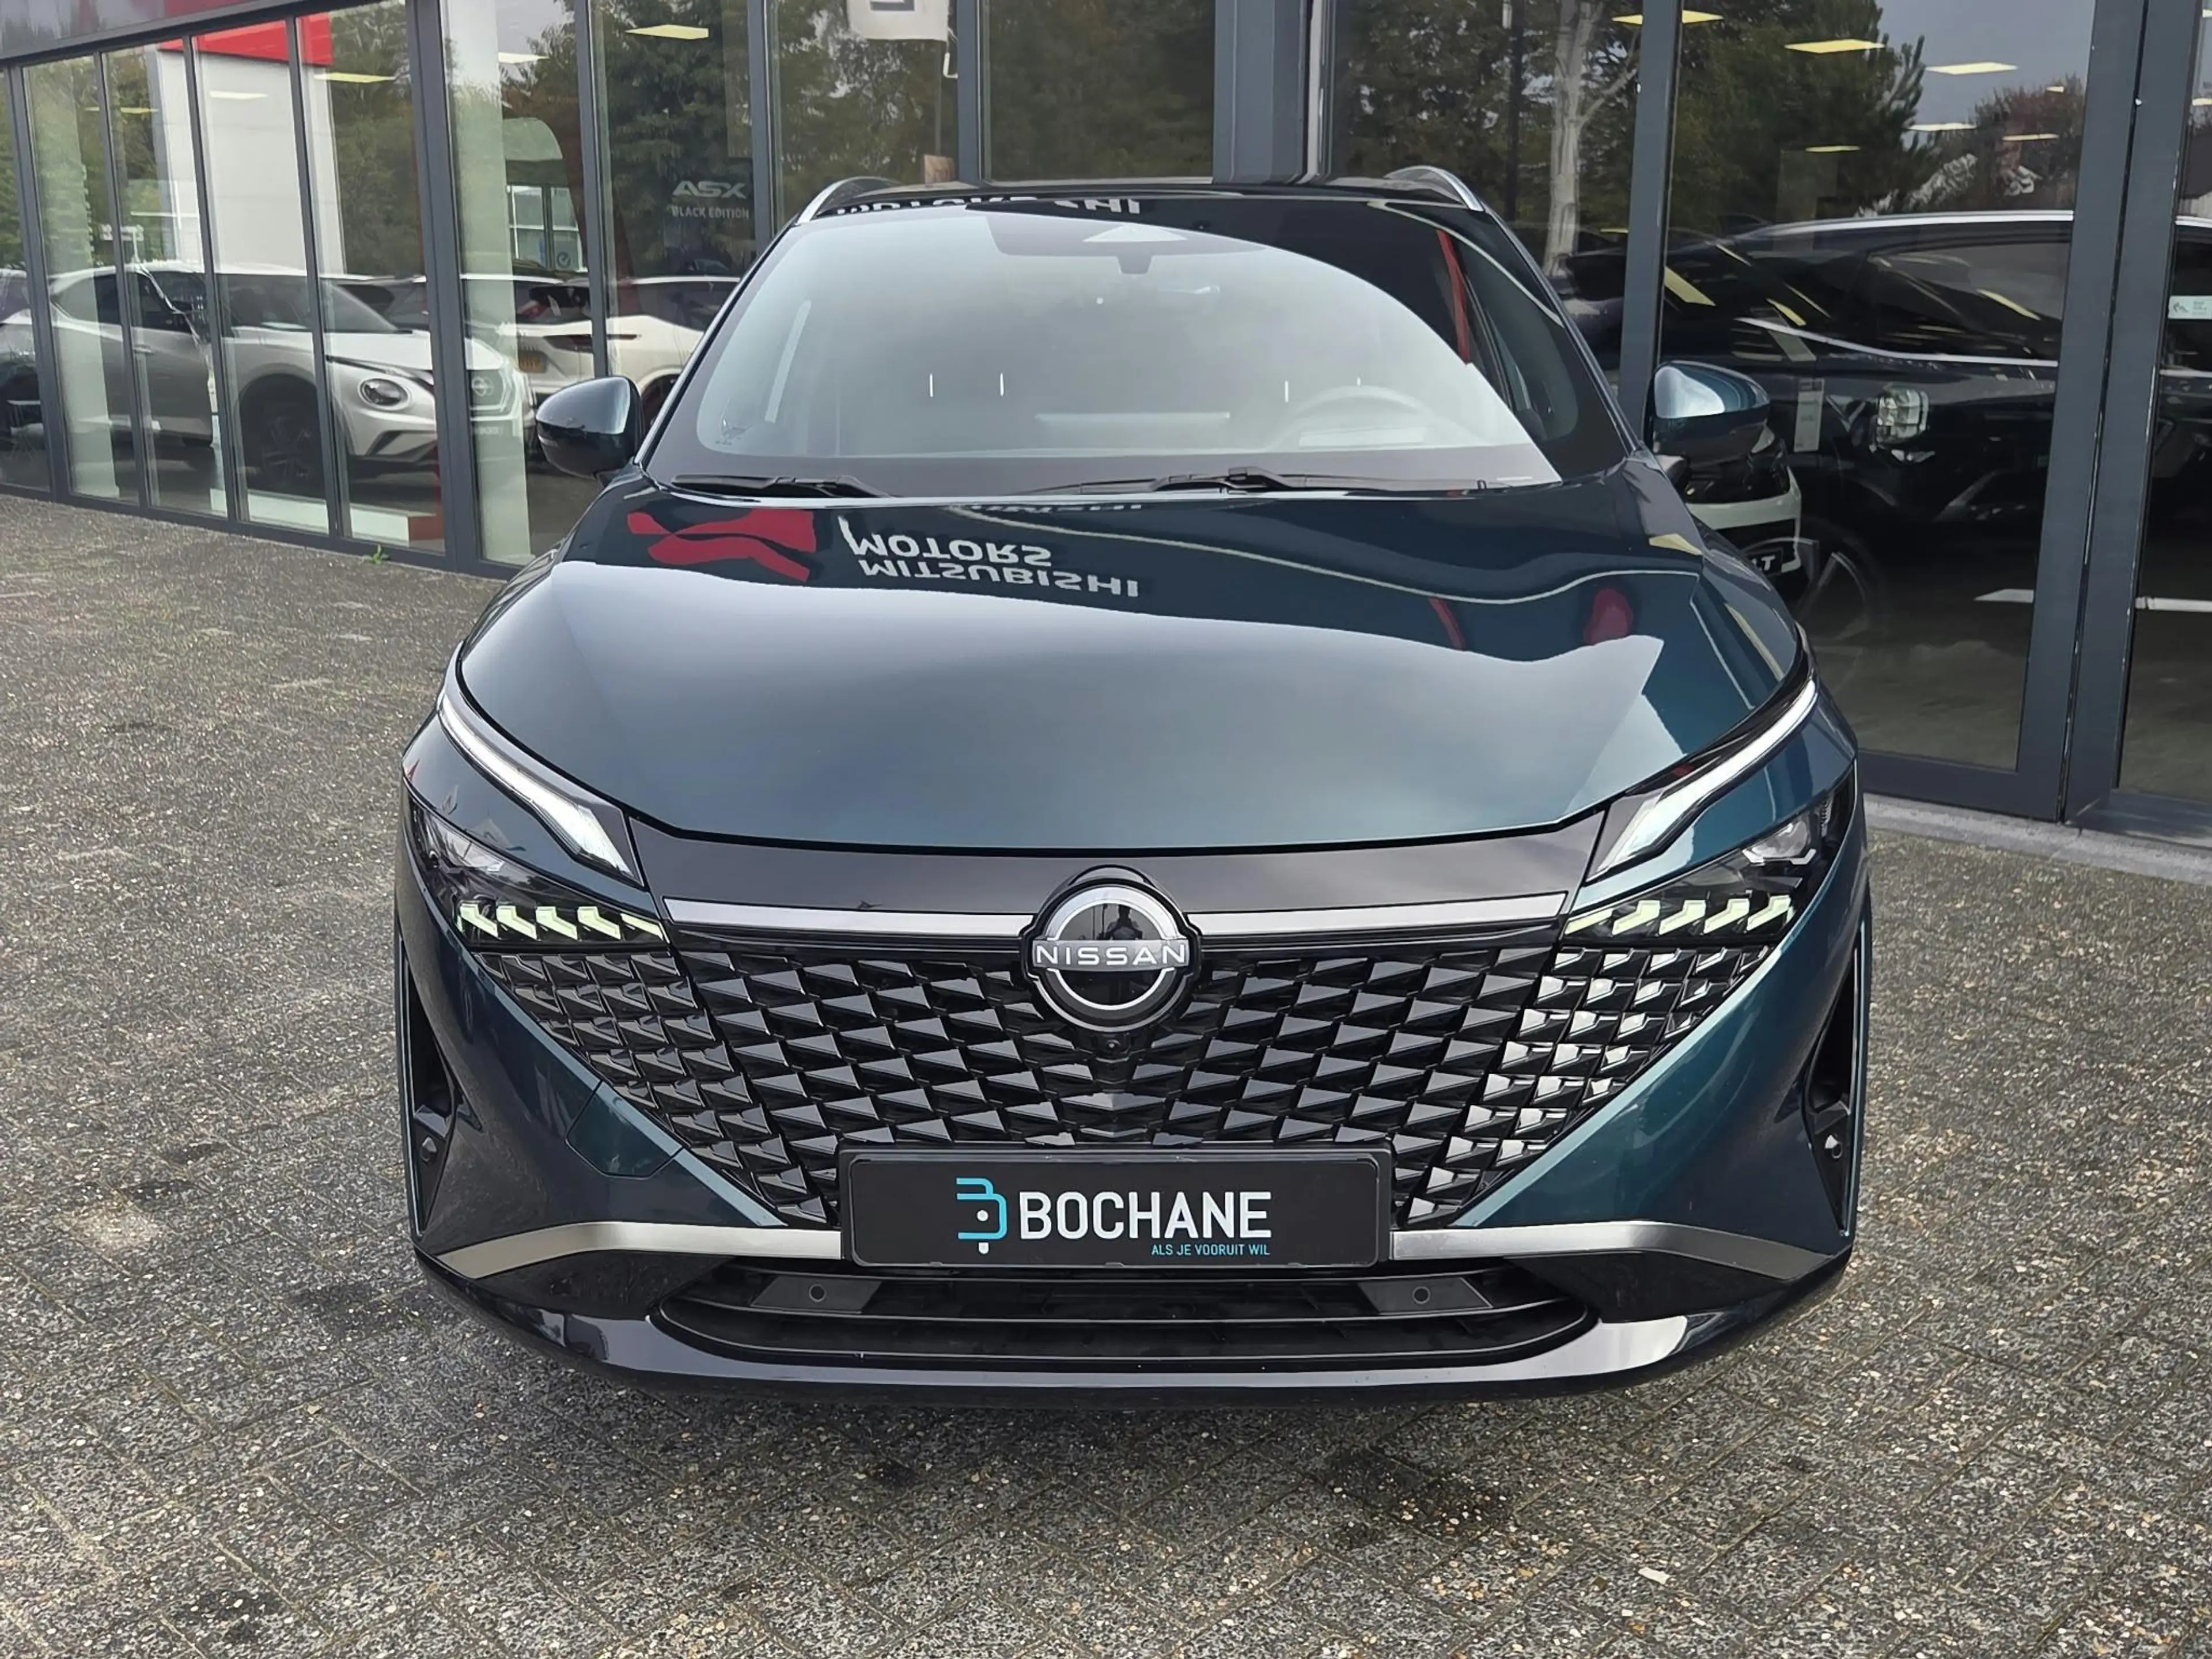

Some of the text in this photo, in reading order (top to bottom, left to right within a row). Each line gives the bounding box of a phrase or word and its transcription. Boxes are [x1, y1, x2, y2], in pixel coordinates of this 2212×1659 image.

[672, 180, 747, 199] ASX
[672, 205, 749, 219] BLACK EDITION
[1036, 944, 1185, 965] NISSAN
[1019, 1191, 1272, 1239] BOCHANE
[1152, 1244, 1270, 1255] ALS JE VOORUIT WIL
